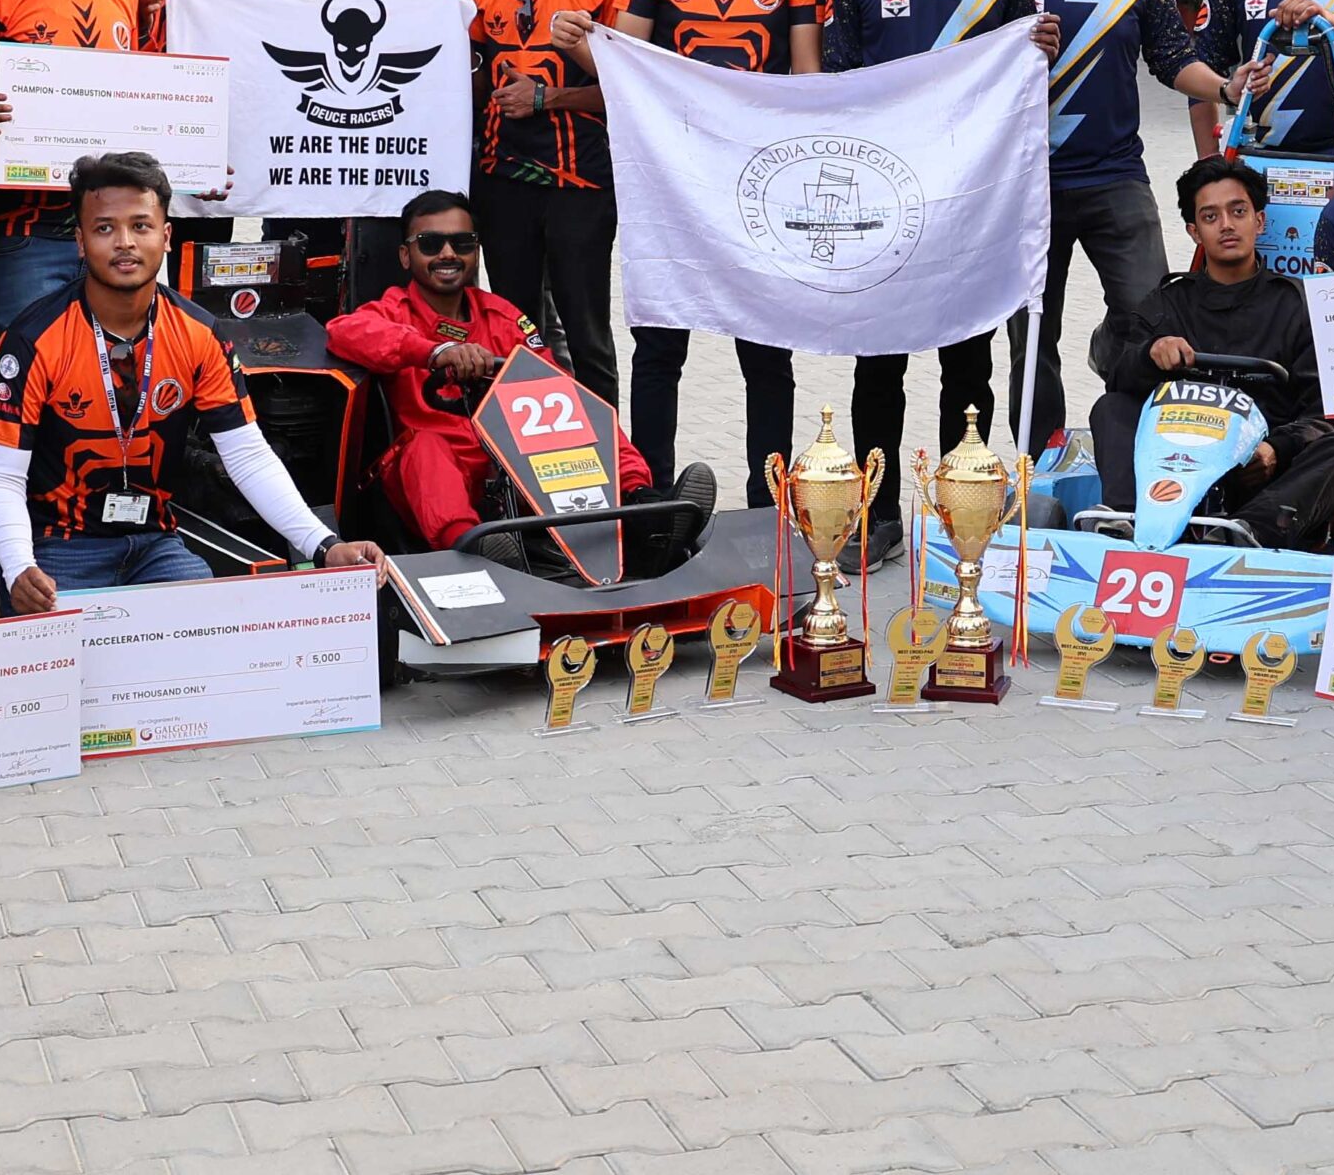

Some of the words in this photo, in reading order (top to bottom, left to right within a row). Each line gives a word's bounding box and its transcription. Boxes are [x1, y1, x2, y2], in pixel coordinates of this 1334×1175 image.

[12, 85, 54, 95] CHAMPION
[61, 88, 112, 98] COMBUSTION
[113, 91, 139, 99] INDIAN
[141, 93, 173, 102] KARTING
[175, 95, 194, 103] RACE
[311, 105, 346, 125] DEUCE
[350, 105, 392, 125] RACERS
[180, 126, 205, 135] 60,000
[34, 136, 52, 144] SIXTY
[53, 137, 88, 145] THOUSAND
[89, 138, 107, 146] ONLY
[270, 137, 295, 153] WE
[299, 137, 333, 153] ARE
[338, 137, 370, 154] THE
[375, 137, 427, 155] DEUCE
[743, 144, 807, 200] SAEINDIA
[811, 140, 913, 189] COLLEGIATE
[270, 168, 293, 186] WE
[299, 168, 332, 185] ARE
[337, 168, 369, 185] THE
[374, 168, 430, 186] DEVILS
[743, 207, 767, 238] LPU
[781, 207, 891, 222] MECHANICAL
[903, 194, 919, 240] CLUB
[1154, 381, 1252, 411] Ansys
[512, 393, 583, 436] 22
[1196, 415, 1225, 427] INDIA
[571, 460, 599, 472] INDIA
[1103, 570, 1173, 617] 29
[89, 632, 164, 647] ACCELERATION
[174, 625, 239, 639] COMBUSTION
[241, 621, 275, 632] INDIAN
[277, 617, 319, 629] KARTING
[321, 615, 346, 625] RACE
[348, 612, 371, 623] 2024
[20, 661, 48, 673] RACE
[50, 657, 75, 670] 2024
[313, 652, 340, 663] 5,000
[112, 692, 130, 701] FIVE
[133, 688, 181, 700] THOUSAND
[183, 685, 206, 695] ONLY
[11, 701, 40, 715] 5,000
